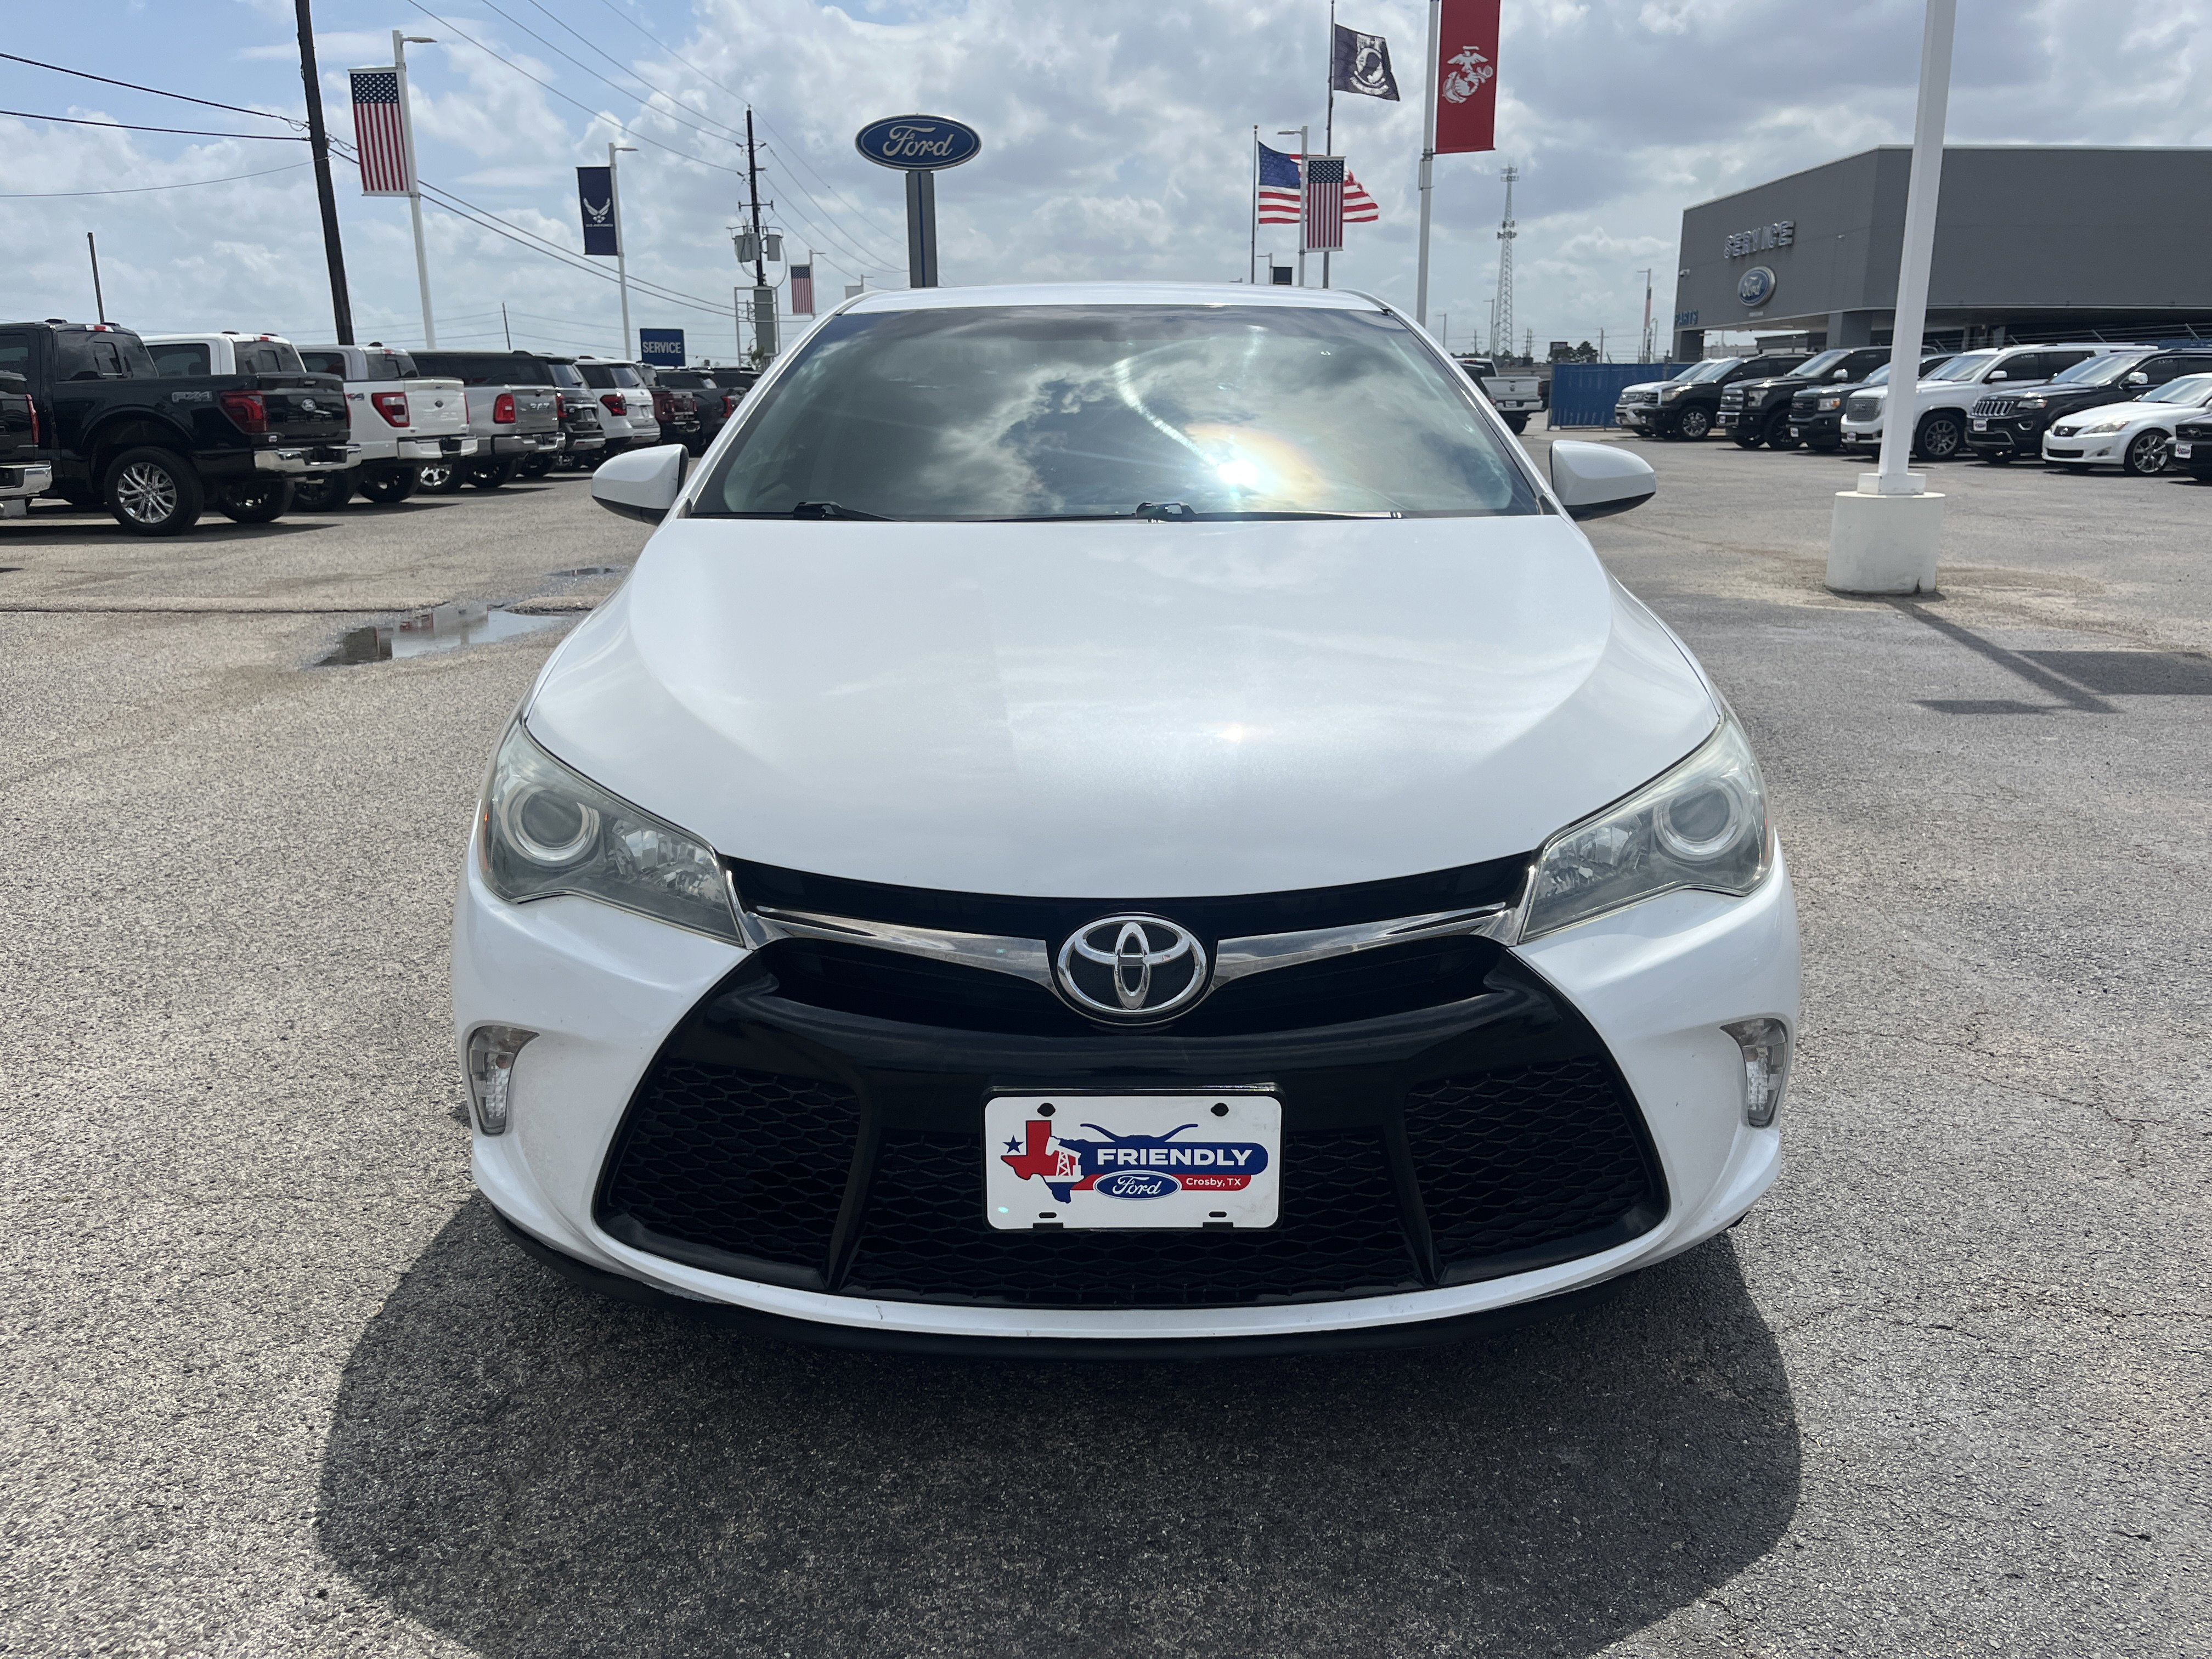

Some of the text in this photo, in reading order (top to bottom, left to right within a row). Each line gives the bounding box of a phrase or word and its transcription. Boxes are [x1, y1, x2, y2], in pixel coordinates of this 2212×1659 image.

[882, 125, 955, 157] Ford
[642, 341, 682, 354] SERVICE
[1097, 1148, 1253, 1166] FRIENDLY
[1111, 1175, 1163, 1195] Ford
[1186, 1177, 1242, 1188] Crosby, TX
